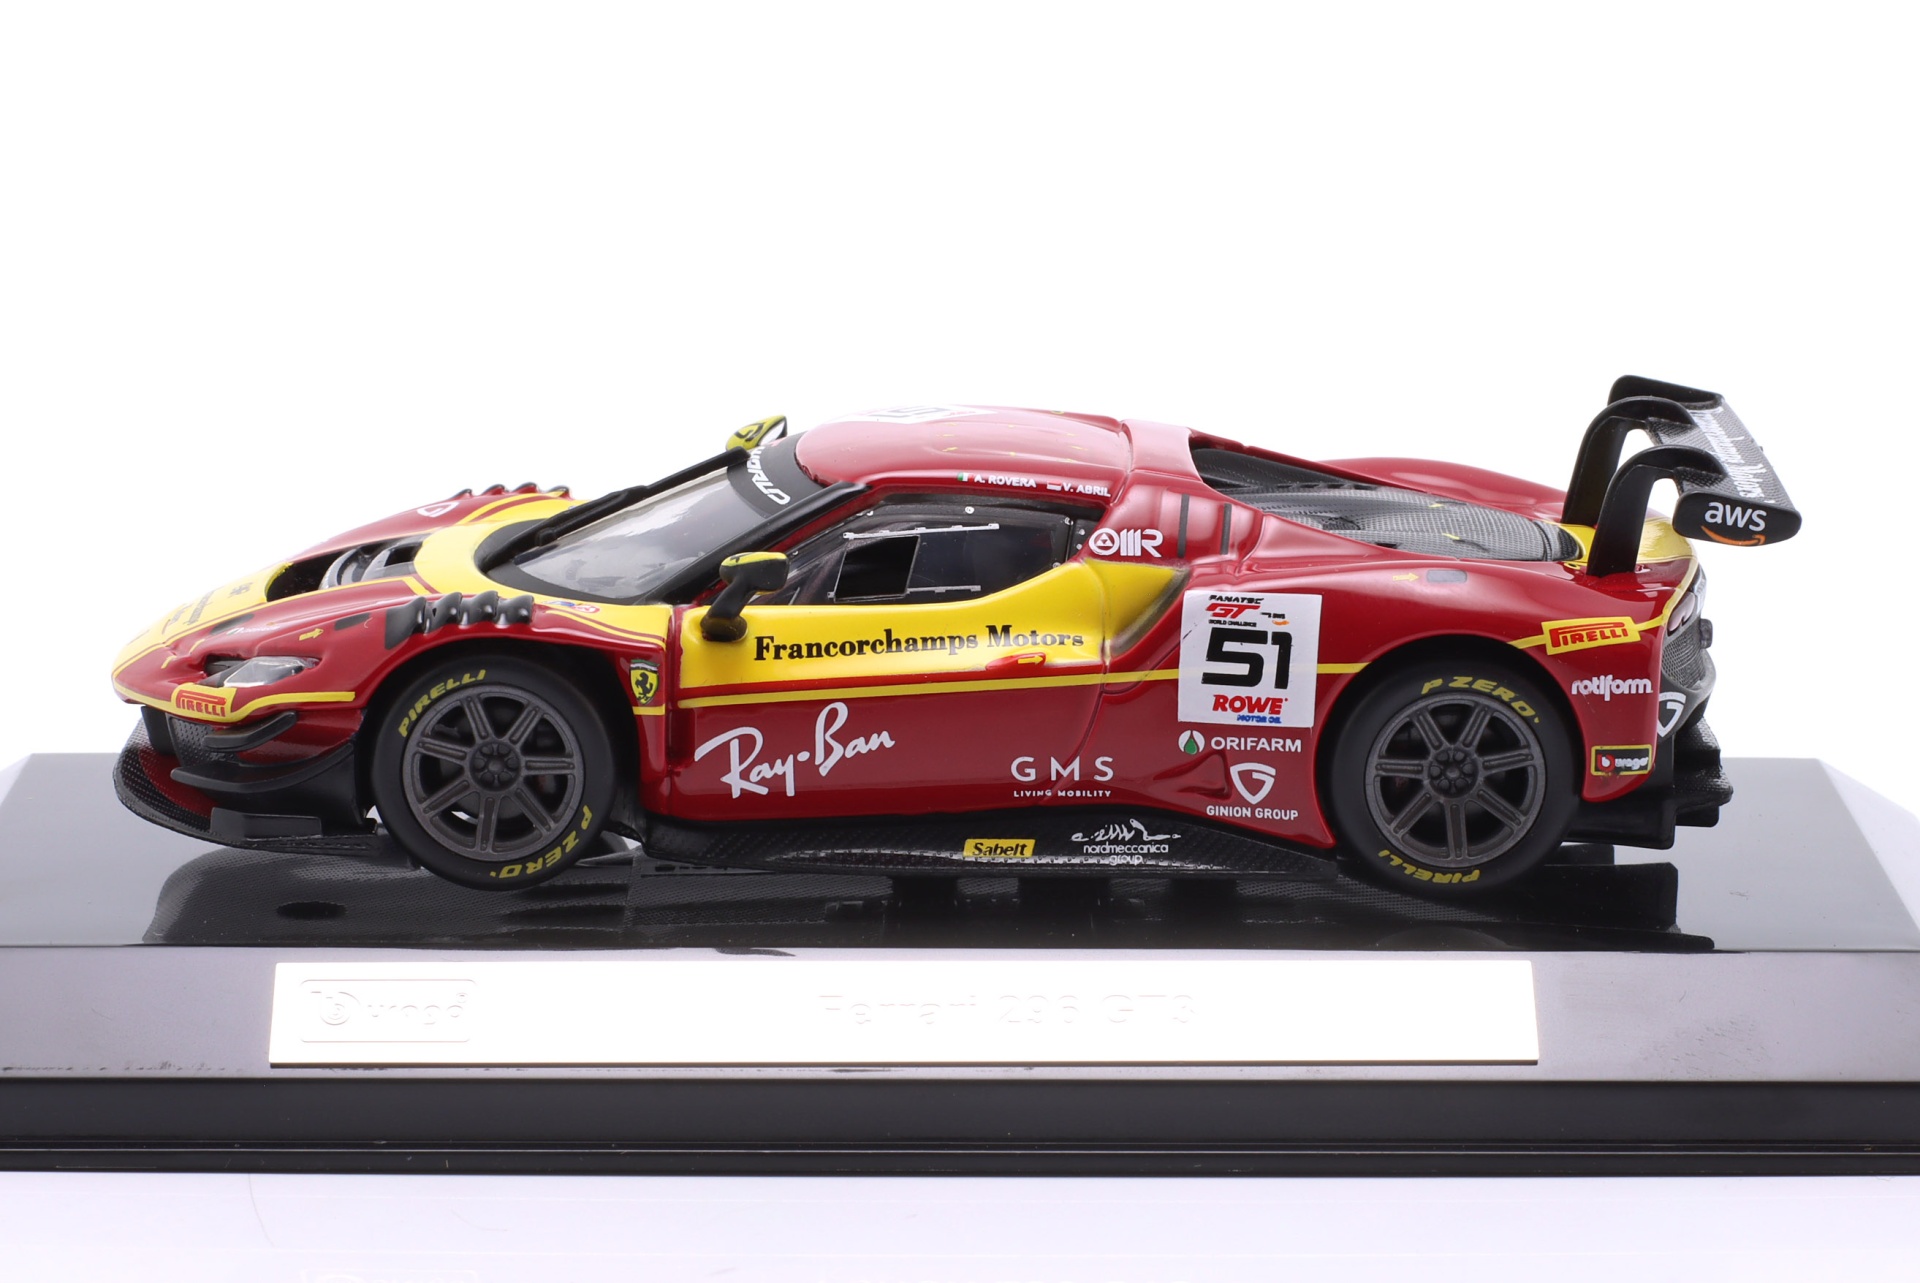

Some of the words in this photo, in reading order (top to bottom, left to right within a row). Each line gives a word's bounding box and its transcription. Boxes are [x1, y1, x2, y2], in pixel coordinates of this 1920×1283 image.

[974, 474, 986, 483] A.
[988, 475, 1037, 488] ROVERA
[1063, 482, 1074, 492] V.
[1076, 484, 1111, 497] ABRIL
[1704, 501, 1767, 532] aws
[1205, 602, 1261, 619] GT
[753, 628, 978, 661] Francorchamps
[986, 624, 1085, 648] Motors
[1549, 621, 1629, 648] PIRELLI
[1201, 627, 1293, 690] 51
[1421, 678, 1443, 695] P
[176, 689, 228, 718] PIRELLI
[398, 669, 487, 738] PIRELLI
[1212, 694, 1284, 715] ROWE
[1211, 736, 1302, 753] ORIFARM
[1010, 755, 1114, 782] GMS
[1013, 789, 1053, 797] LIVING
[1057, 789, 1112, 797] MOBILITY
[1206, 805, 1251, 818] GINION
[1254, 807, 1298, 820] GROUP
[972, 841, 1028, 856] Sabelt
[1083, 841, 1169, 854] nordmeccanica
[1109, 855, 1143, 866] group
[1378, 849, 1481, 884] PIRELLI
